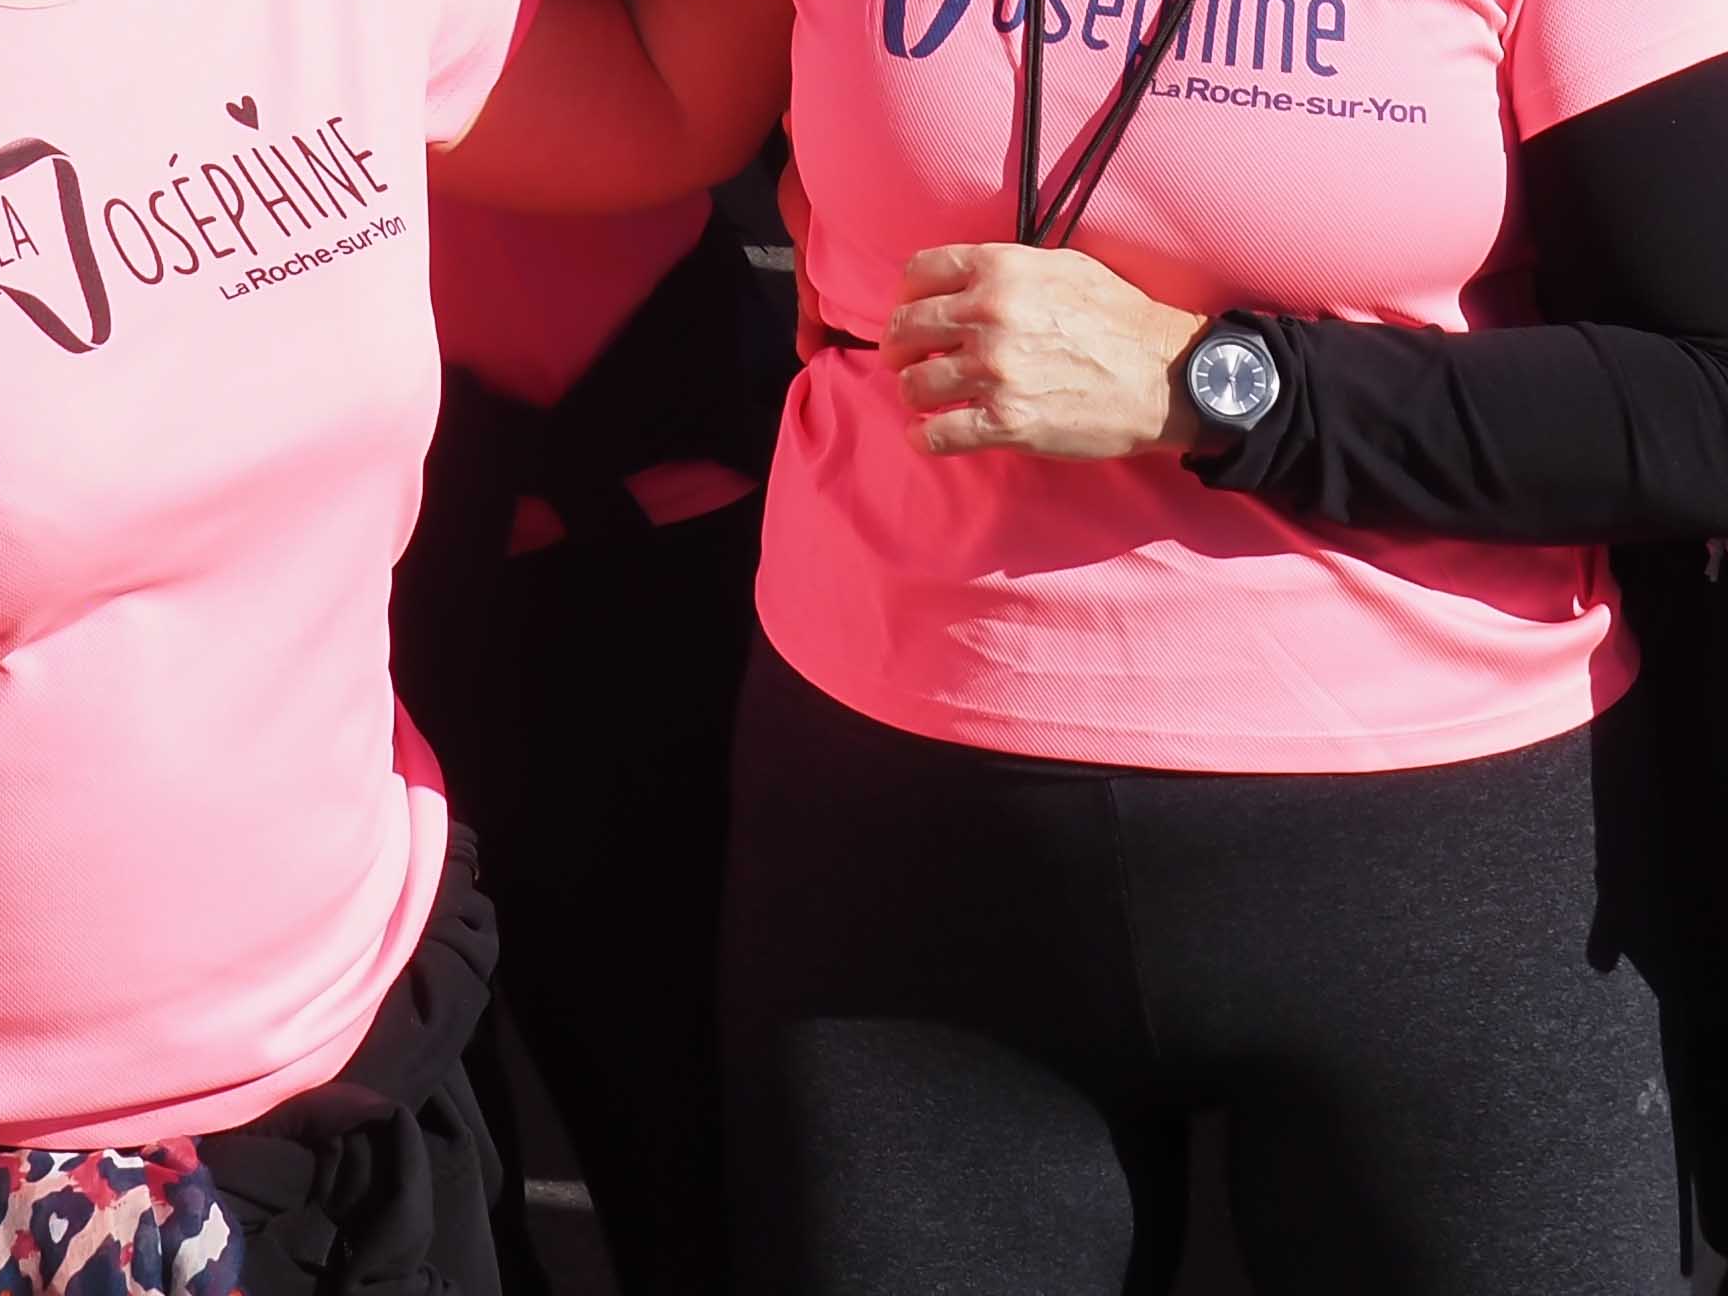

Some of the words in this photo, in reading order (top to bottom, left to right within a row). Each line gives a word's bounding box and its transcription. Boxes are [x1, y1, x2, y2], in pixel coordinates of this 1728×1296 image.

[1148, 76, 1181, 99] La
[1184, 75, 1428, 126] Roche-sur-Yon
[218, 275, 251, 301] La
[246, 211, 407, 291] Roche-sur-Yon
